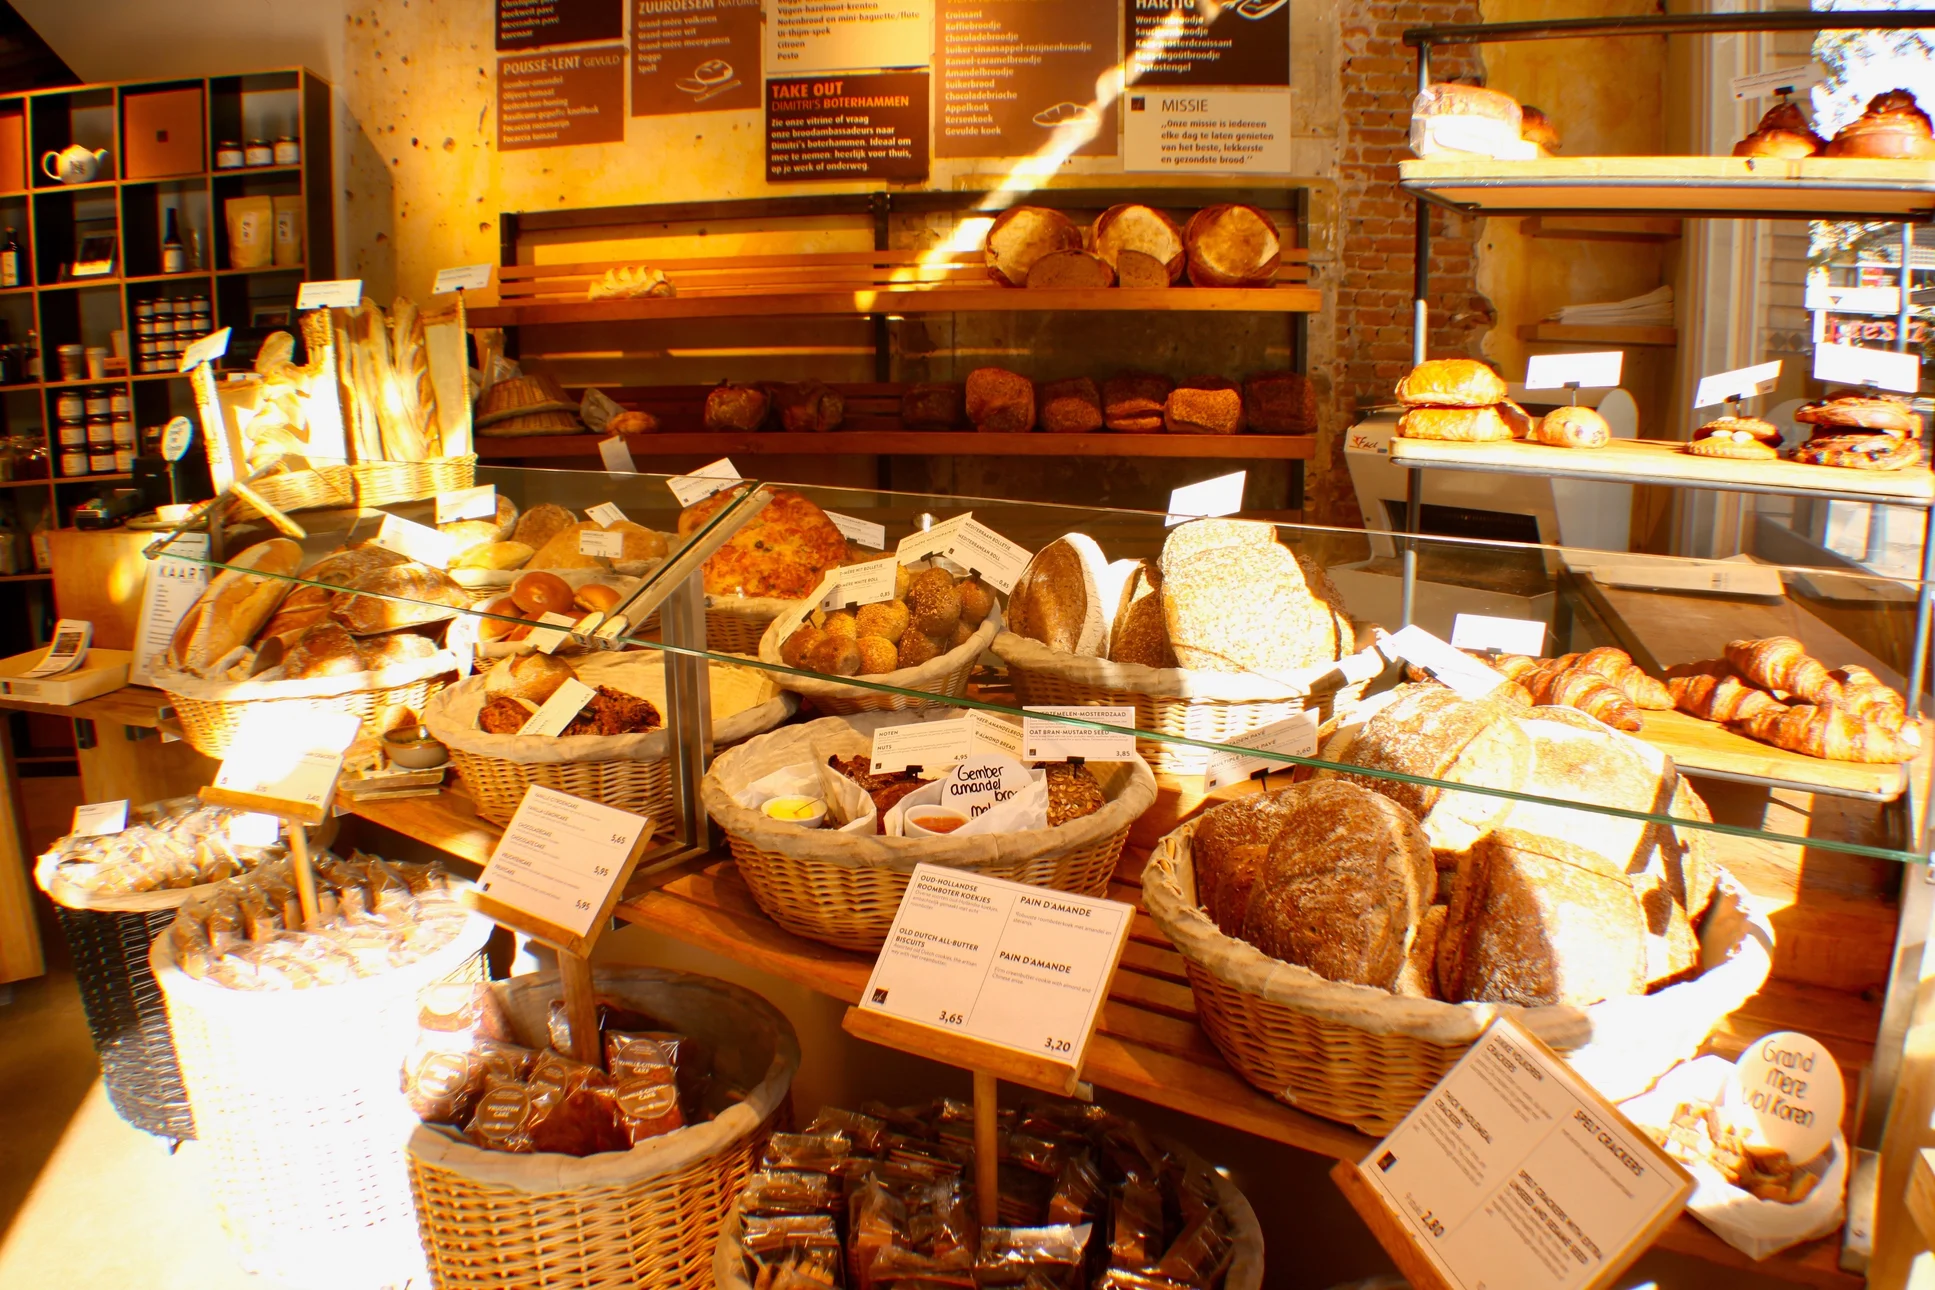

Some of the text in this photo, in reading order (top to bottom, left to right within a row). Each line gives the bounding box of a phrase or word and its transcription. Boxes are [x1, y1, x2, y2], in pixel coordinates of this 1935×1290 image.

[1135, 0, 1195, 10] HARTIG
[945, 11, 982, 20] Croissant
[778, 17, 823, 26] Notenbrood
[945, 21, 1001, 31] Koffiebroodje
[684, 28, 696, 36] wit
[778, 27, 831, 38] Ui-thijm-spek
[945, 32, 1019, 43] Chocoladebroodje
[684, 37, 730, 48] meergranen
[778, 41, 805, 49] Citroen
[777, 52, 799, 60] Pesto
[945, 55, 1042, 66] Kaneel-caramelbroodje
[503, 55, 620, 75] POUSSE-LENT GEVULD
[638, 64, 657, 74] Spelt
[945, 67, 1014, 78] Amandelbroodje
[772, 81, 843, 98] TAKE OUT
[945, 79, 995, 89] Suikerbrood
[945, 90, 1017, 101] Chocoladebrioche
[772, 96, 909, 112] DIMITRI'S BOTERHAMMEN
[945, 103, 989, 113] Appelkoek
[1161, 99, 1209, 112] MISSIE
[771, 118, 783, 127] Zie
[807, 116, 833, 125] vitrine
[835, 114, 843, 123] of
[846, 115, 869, 125] vraag
[945, 115, 993, 124] Kersenkoek
[1190, 120, 1267, 128] missie is iedereen
[792, 127, 874, 138] broodambassadeurs
[945, 126, 1001, 136] Gevulde koek
[1161, 131, 1274, 142] elke dag te laten genieten
[771, 140, 805, 150] Dimitri's
[808, 138, 867, 148] boterhammen.
[870, 138, 895, 146] Ideaal
[1179, 143, 1193, 151] het
[1195, 143, 1222, 153] beste,
[1224, 144, 1263, 152] lekkerste
[792, 153, 800, 161] te
[802, 152, 832, 160] nemen:
[835, 150, 866, 160] heerlijk
[889, 149, 912, 159] thuis,
[1174, 155, 1217, 166] gezondste
[771, 162, 869, 175] op je werk of onderweg.
[965, 522, 993, 542] MEDITERRAAN
[958, 533, 1001, 561] MEDITERRANEAN ROLL
[159, 566, 206, 581] KAART
[998, 580, 1010, 589] 0,85
[1250, 730, 1266, 740] PAVÉ
[1000, 741, 1016, 750] BREAD
[1261, 739, 1276, 748] PAVÉ
[1296, 746, 1311, 756] 2,60
[957, 764, 1004, 781] Gember
[950, 778, 1000, 795] amandel
[610, 834, 627, 845] 5,65
[593, 866, 609, 877] 5,95
[921, 875, 978, 892] OUD-HOLLANDSE
[917, 883, 991, 904] ROOMBOTER KOEKJES
[575, 899, 591, 911] 5,95
[1020, 896, 1092, 917] PAIN D'AMANDE
[895, 936, 925, 948] BISCUITS
[914, 931, 938, 942] DUTCH
[939, 937, 979, 951] ALL-BUTTER
[999, 951, 1072, 974] PAIN D'AMANDE
[1052, 979, 1063, 987] with
[939, 1010, 963, 1025] 3,65
[1044, 1037, 1071, 1053] 3,20
[1486, 1043, 1517, 1073] CRACKERS
[1762, 1039, 1816, 1072] Grand
[1435, 1098, 1464, 1129] CRACKERS
[1458, 1106, 1493, 1144] WHOLEMEAL
[1573, 1109, 1600, 1134] SPELT
[1597, 1131, 1644, 1176] CRACKERS
[1518, 1169, 1537, 1188] SPELT
[1535, 1187, 1568, 1221] CRACKERS
[1532, 1204, 1549, 1221] AND
[1420, 1209, 1445, 1238] 2,80
